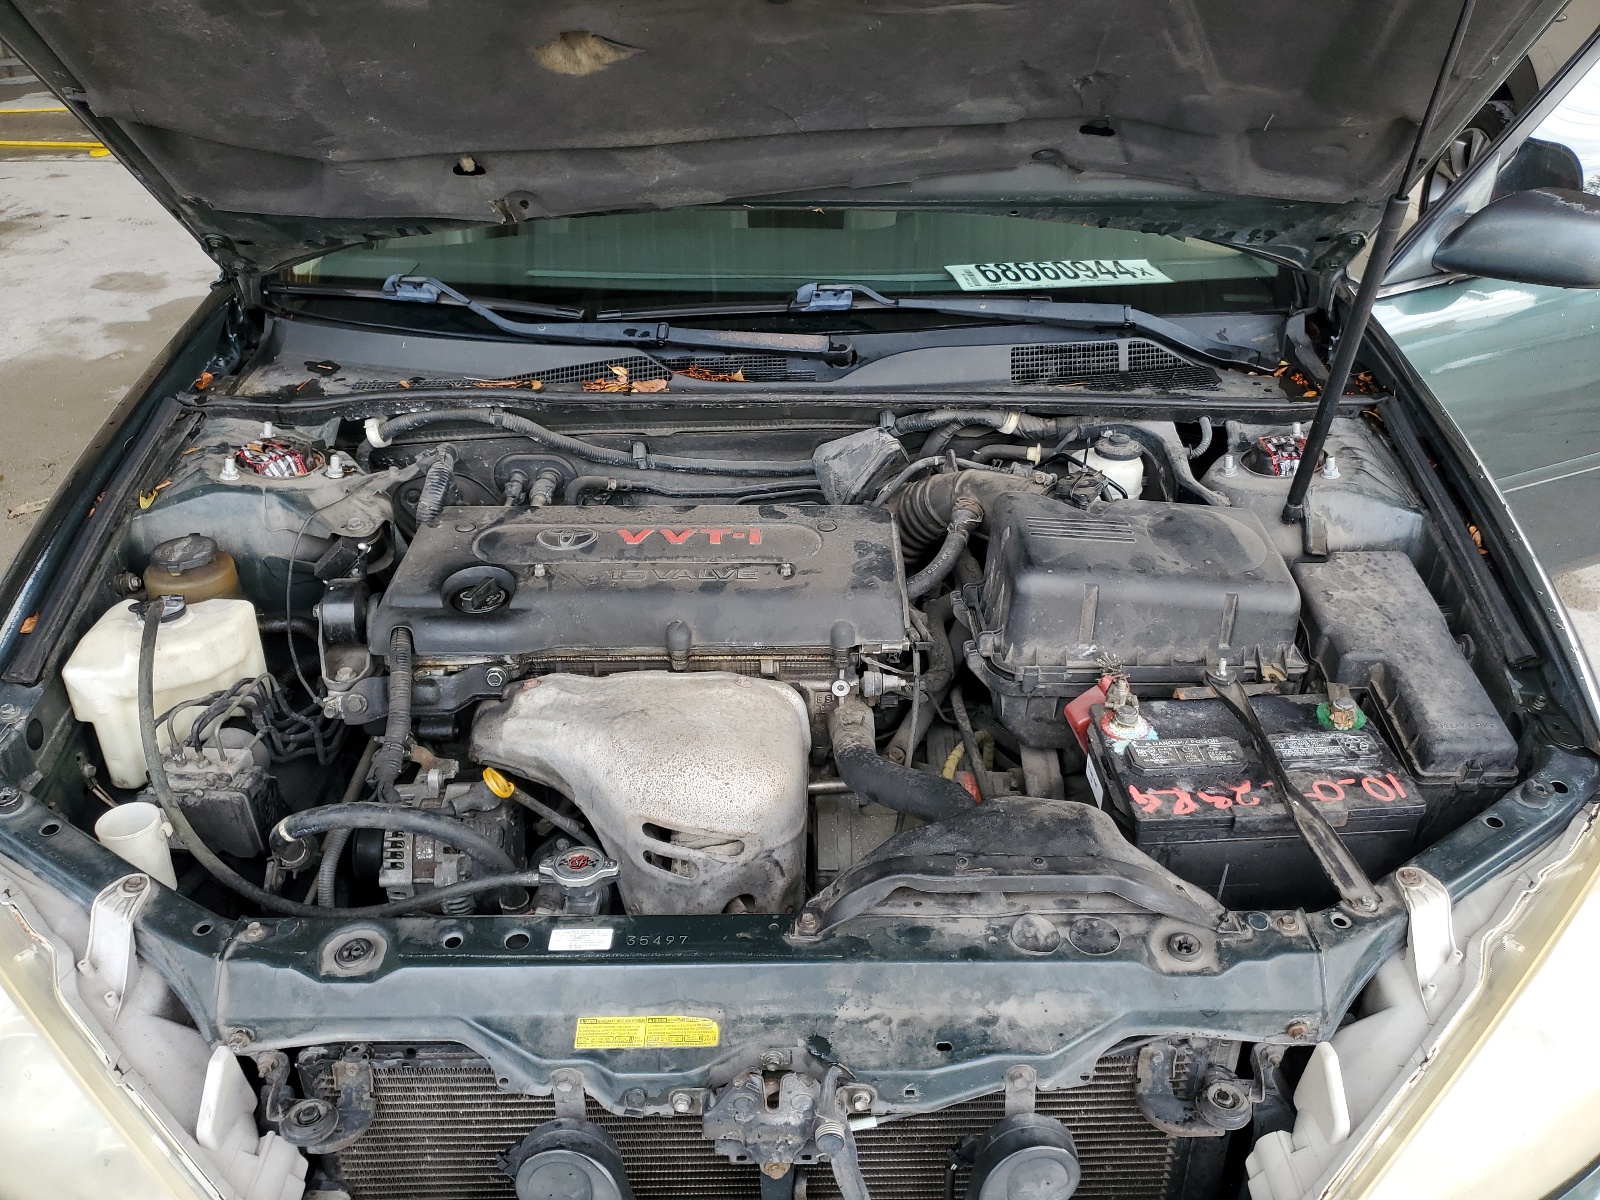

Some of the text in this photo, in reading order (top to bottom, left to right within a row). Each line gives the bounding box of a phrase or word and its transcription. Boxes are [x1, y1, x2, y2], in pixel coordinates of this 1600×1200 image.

[974, 260, 1138, 283] 68660944
[650, 568, 759, 581] VALVE
[626, 935, 689, 946] 35497
